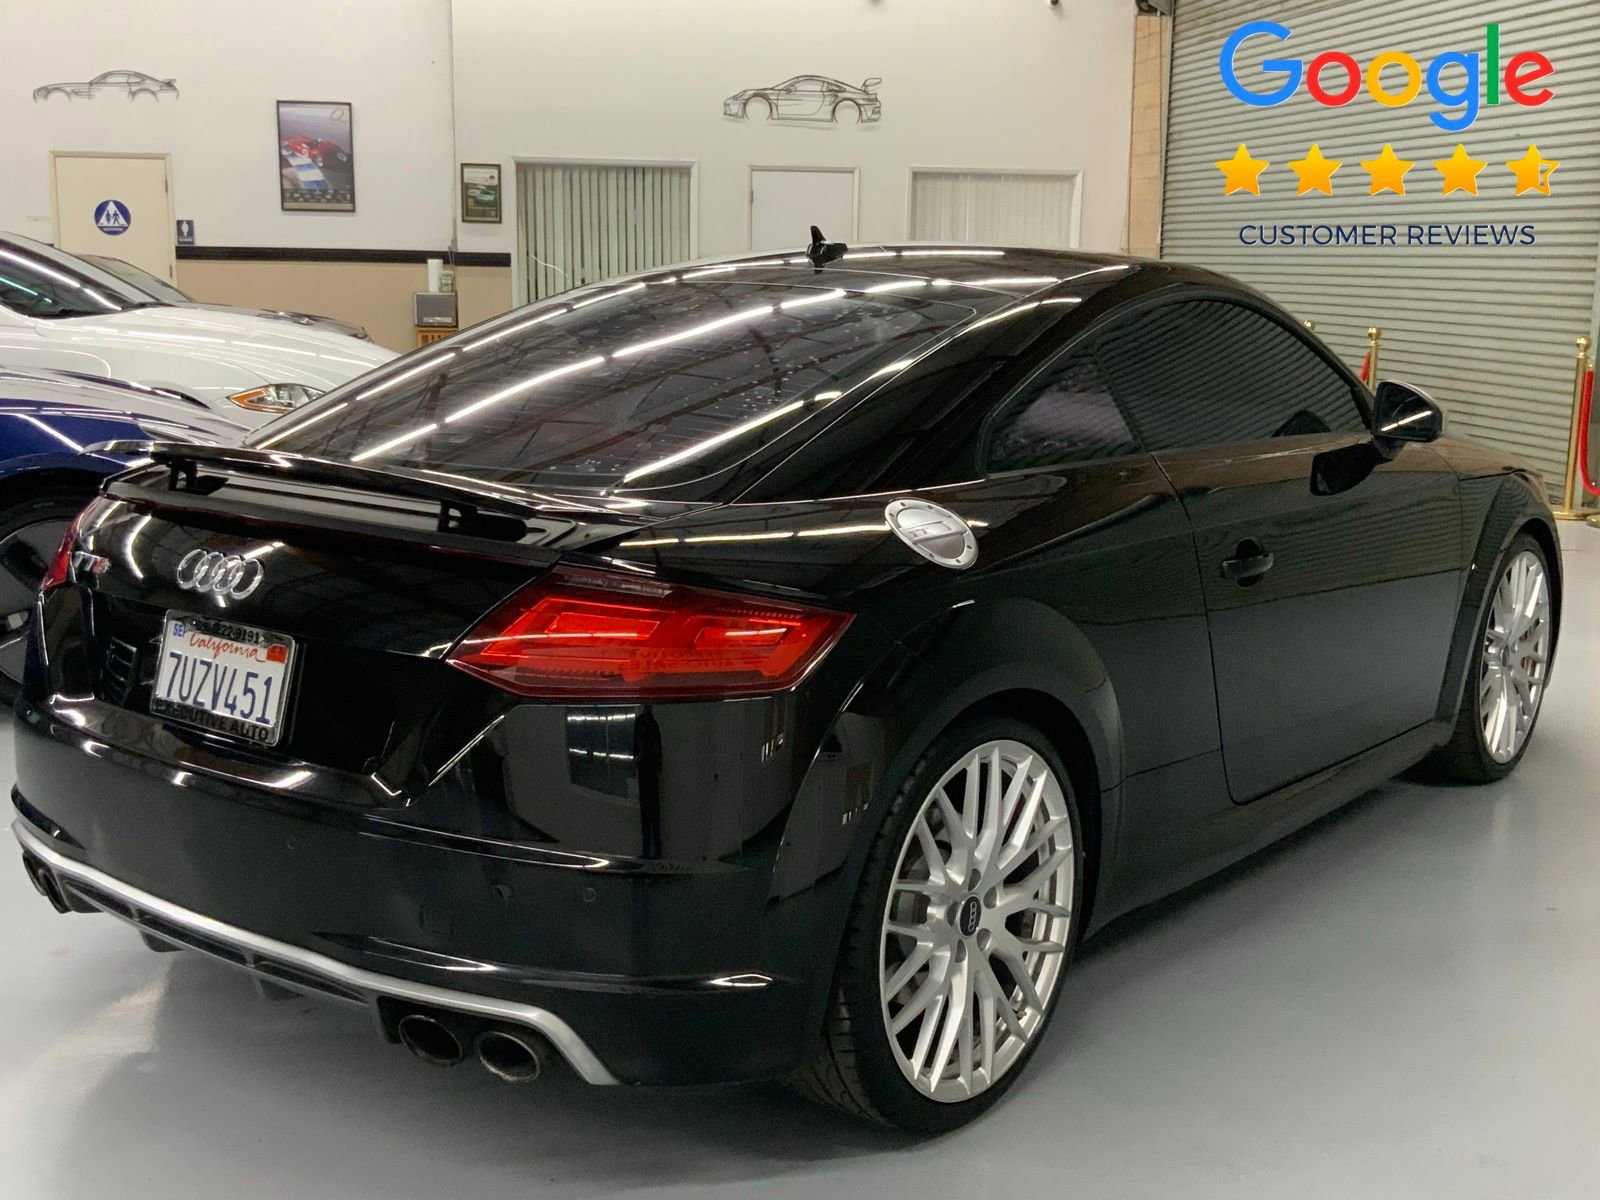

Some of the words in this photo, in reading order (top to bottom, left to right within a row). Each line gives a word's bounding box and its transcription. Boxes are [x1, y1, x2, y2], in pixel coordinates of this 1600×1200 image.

[190, 632, 266, 663] California
[166, 651, 273, 725] 7UZV451
[229, 718, 269, 742] AUTO
